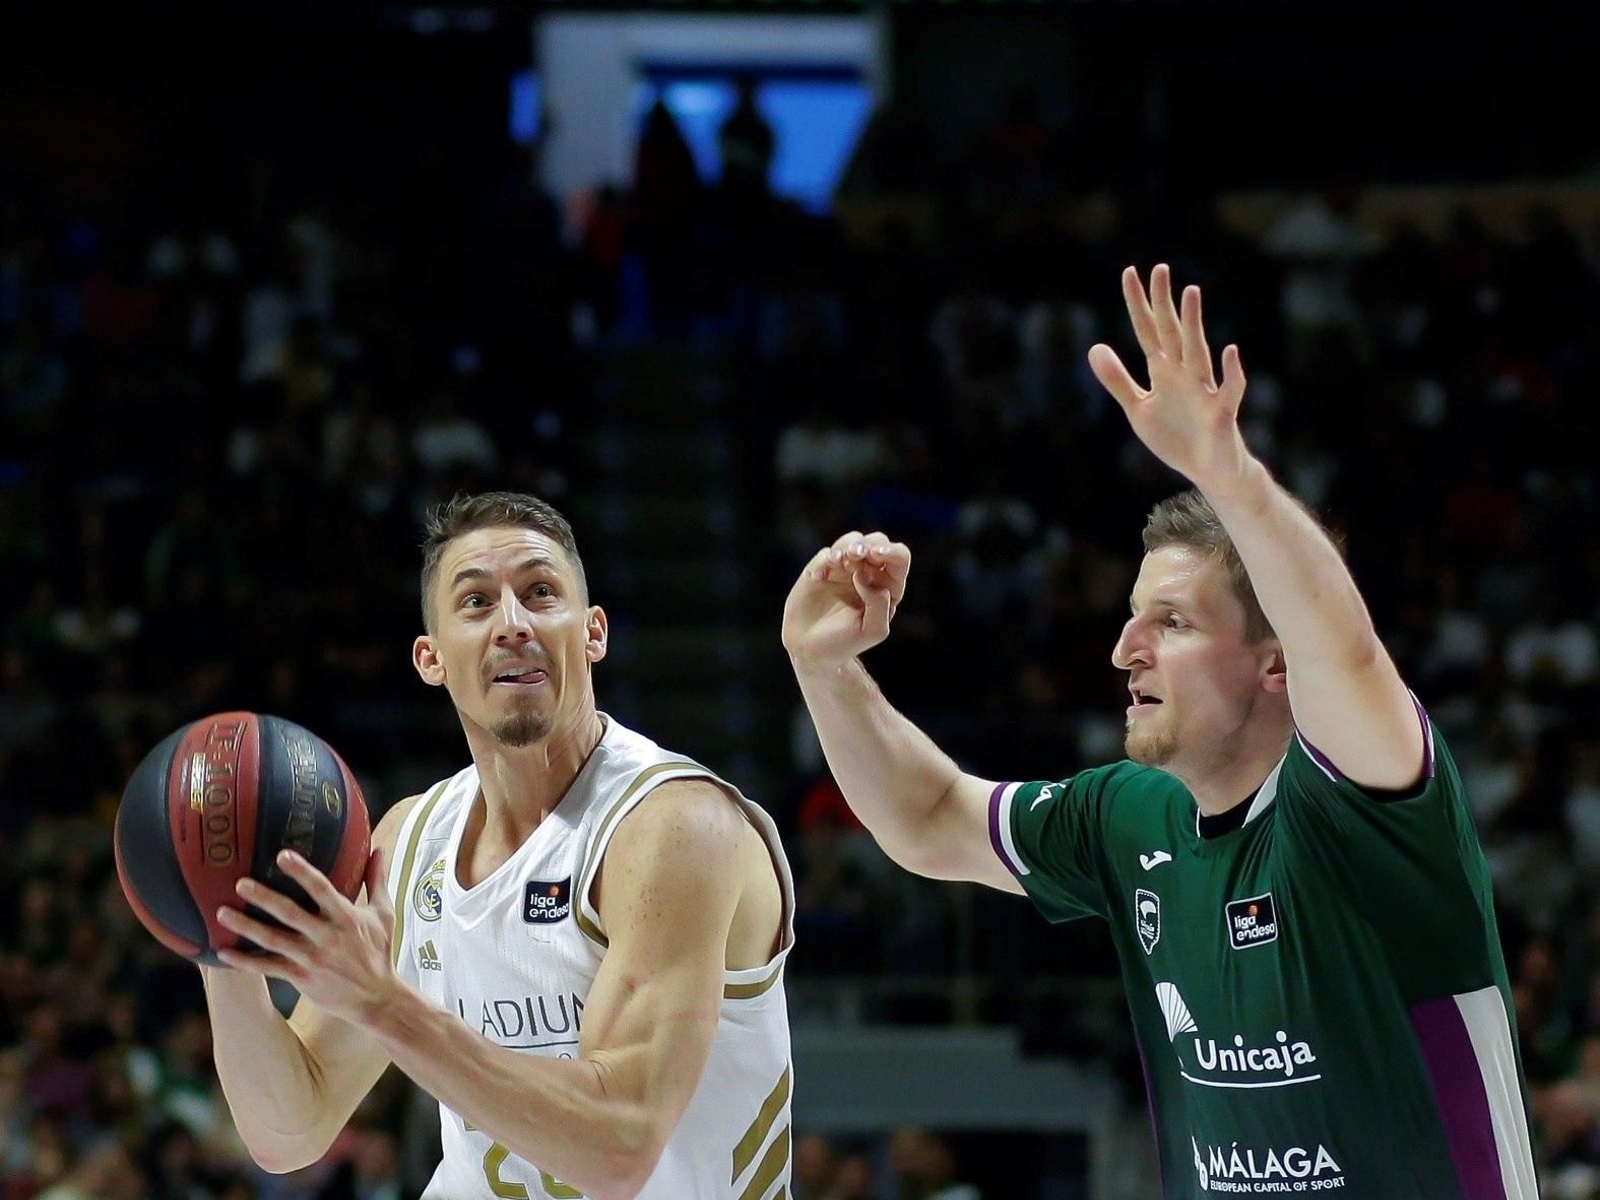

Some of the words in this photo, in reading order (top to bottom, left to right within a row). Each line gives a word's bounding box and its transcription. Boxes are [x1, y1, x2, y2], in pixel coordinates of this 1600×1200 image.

[530, 893, 556, 908] liga
[1233, 915, 1256, 930] liga
[1236, 923, 1275, 941] endesa
[1194, 1030, 1317, 1077] Unicaja
[1208, 1141, 1341, 1179] MÁLAGA
[1210, 1180, 1252, 1193] EUROPEAN
[1253, 1182, 1293, 1193] CAPITAL
[1293, 1180, 1308, 1192] OF
[1311, 1177, 1346, 1191] SPORT
